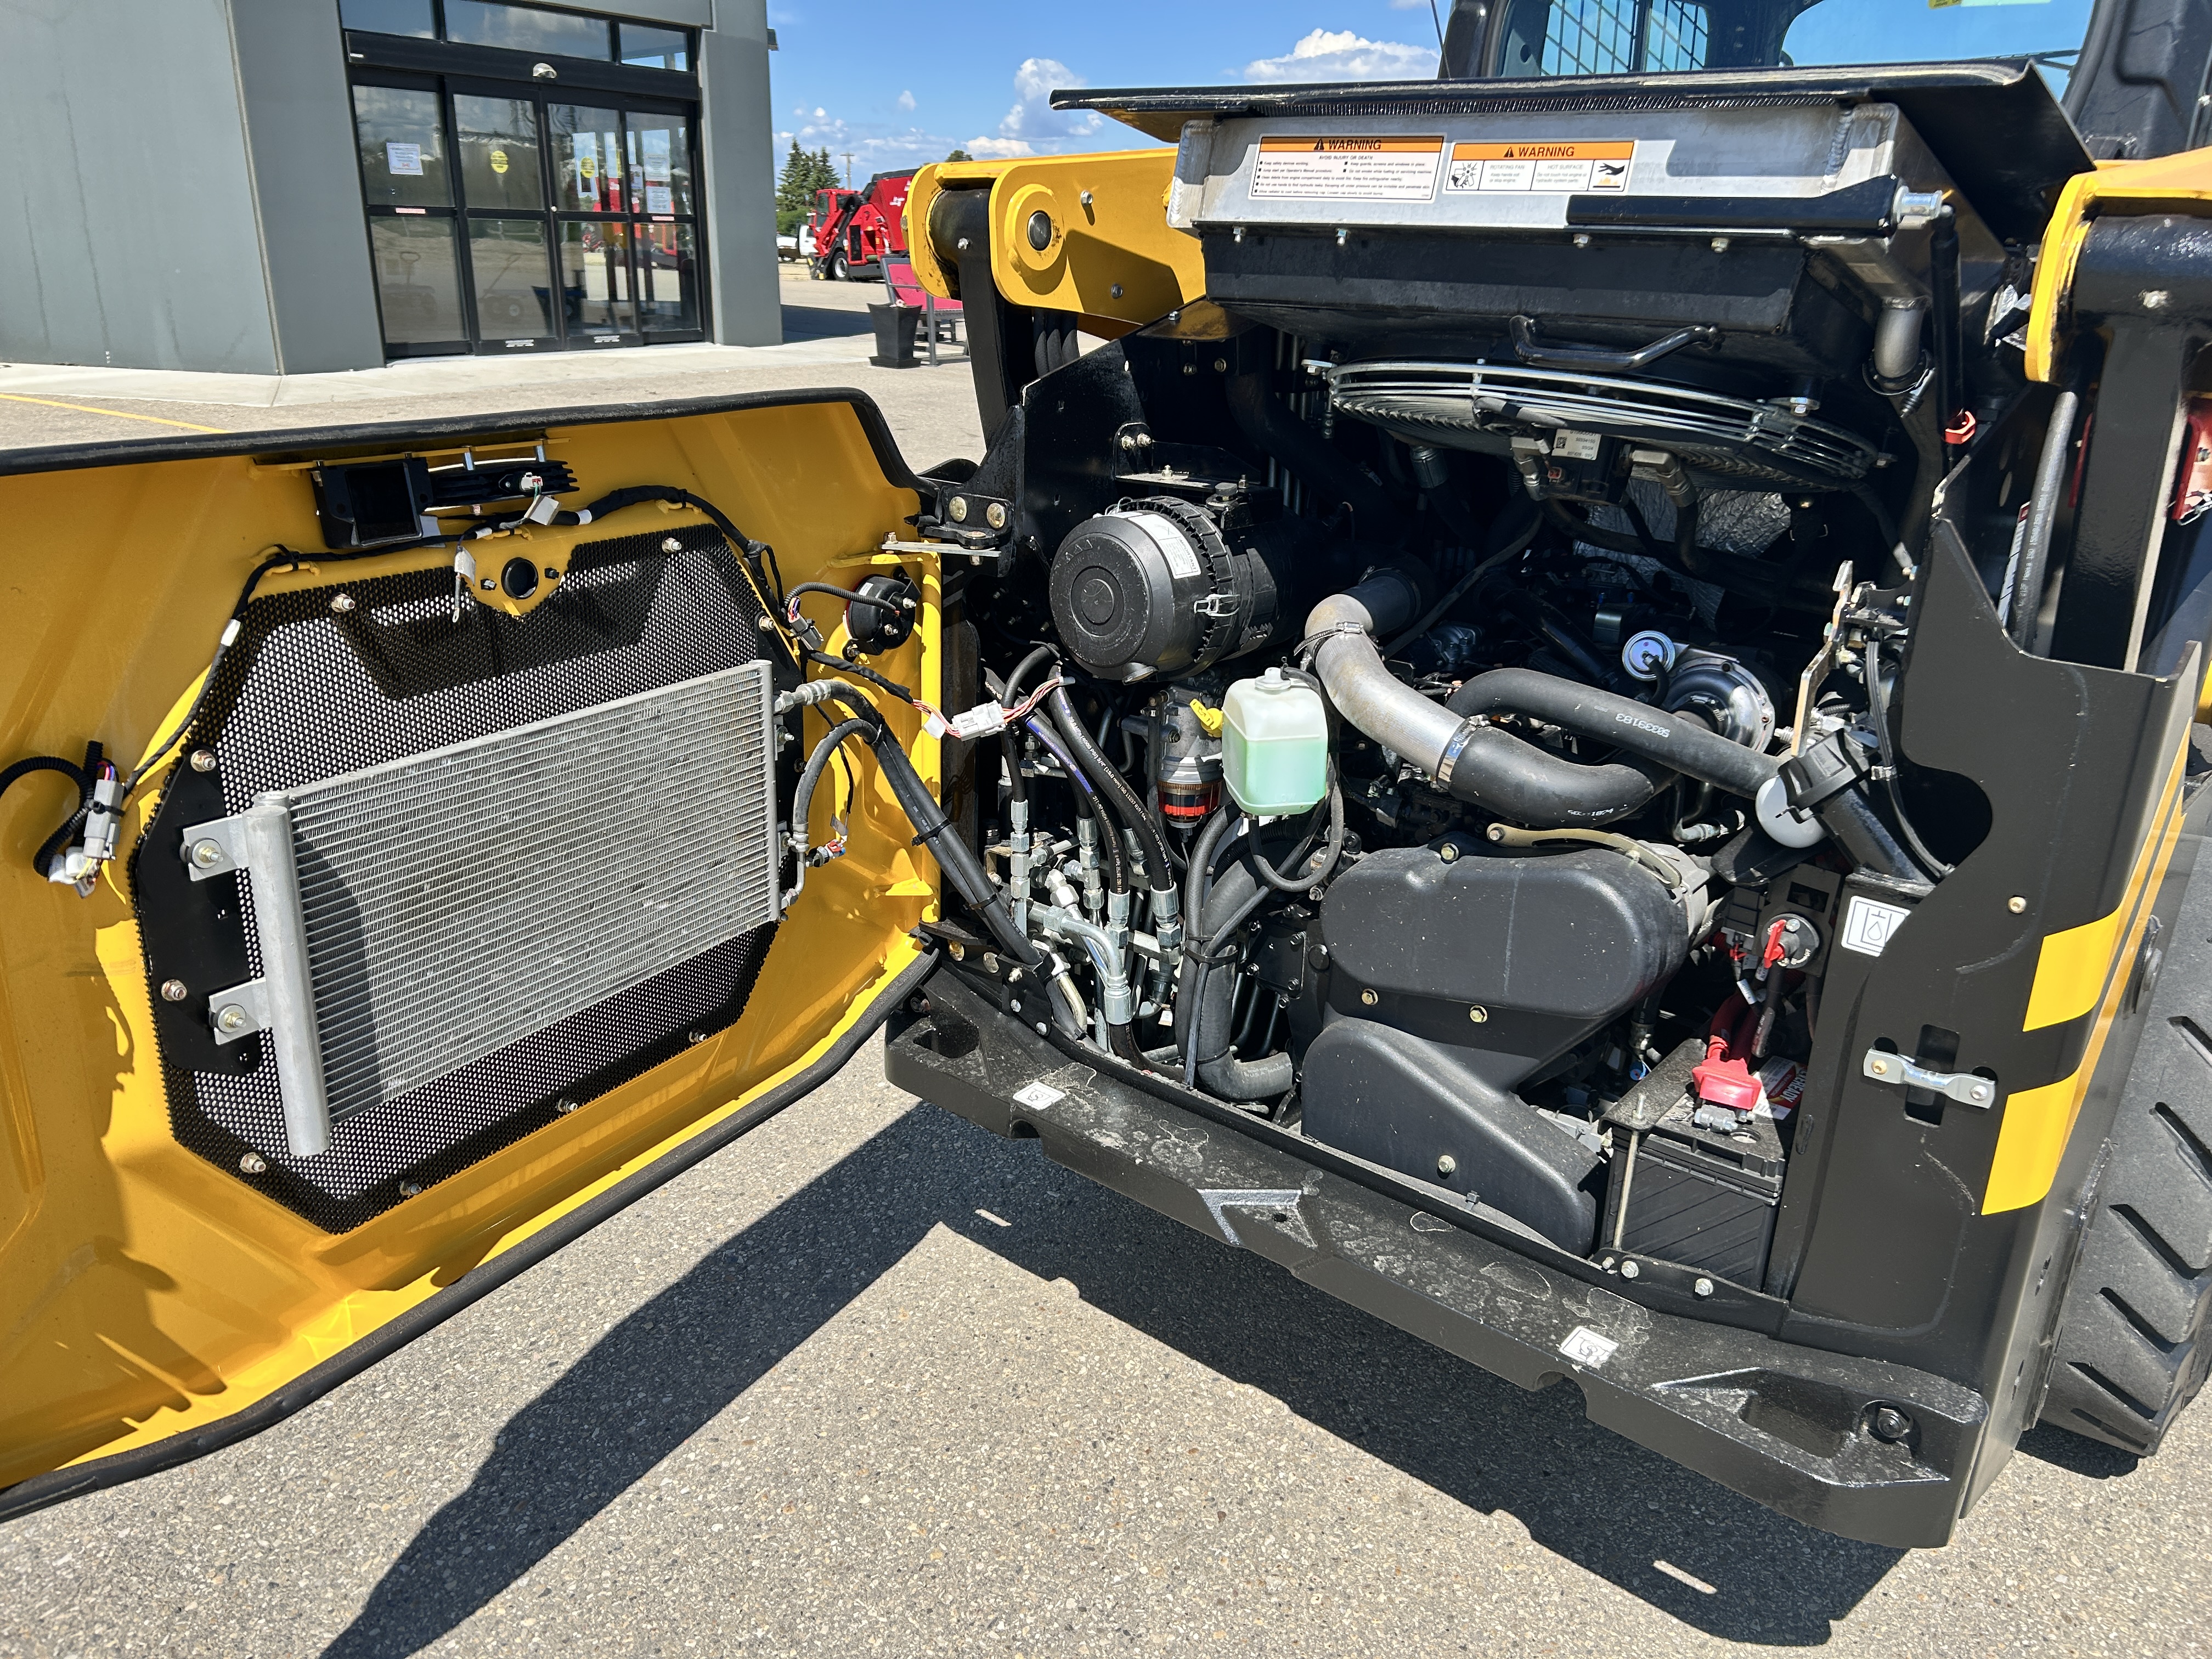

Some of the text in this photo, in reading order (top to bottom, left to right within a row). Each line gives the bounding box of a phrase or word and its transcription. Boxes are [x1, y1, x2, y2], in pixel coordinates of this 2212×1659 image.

[1329, 139, 1381, 150] WARNING
[1519, 146, 1575, 157] WARNING
[1179, 536, 1198, 571] IMPORTANT
